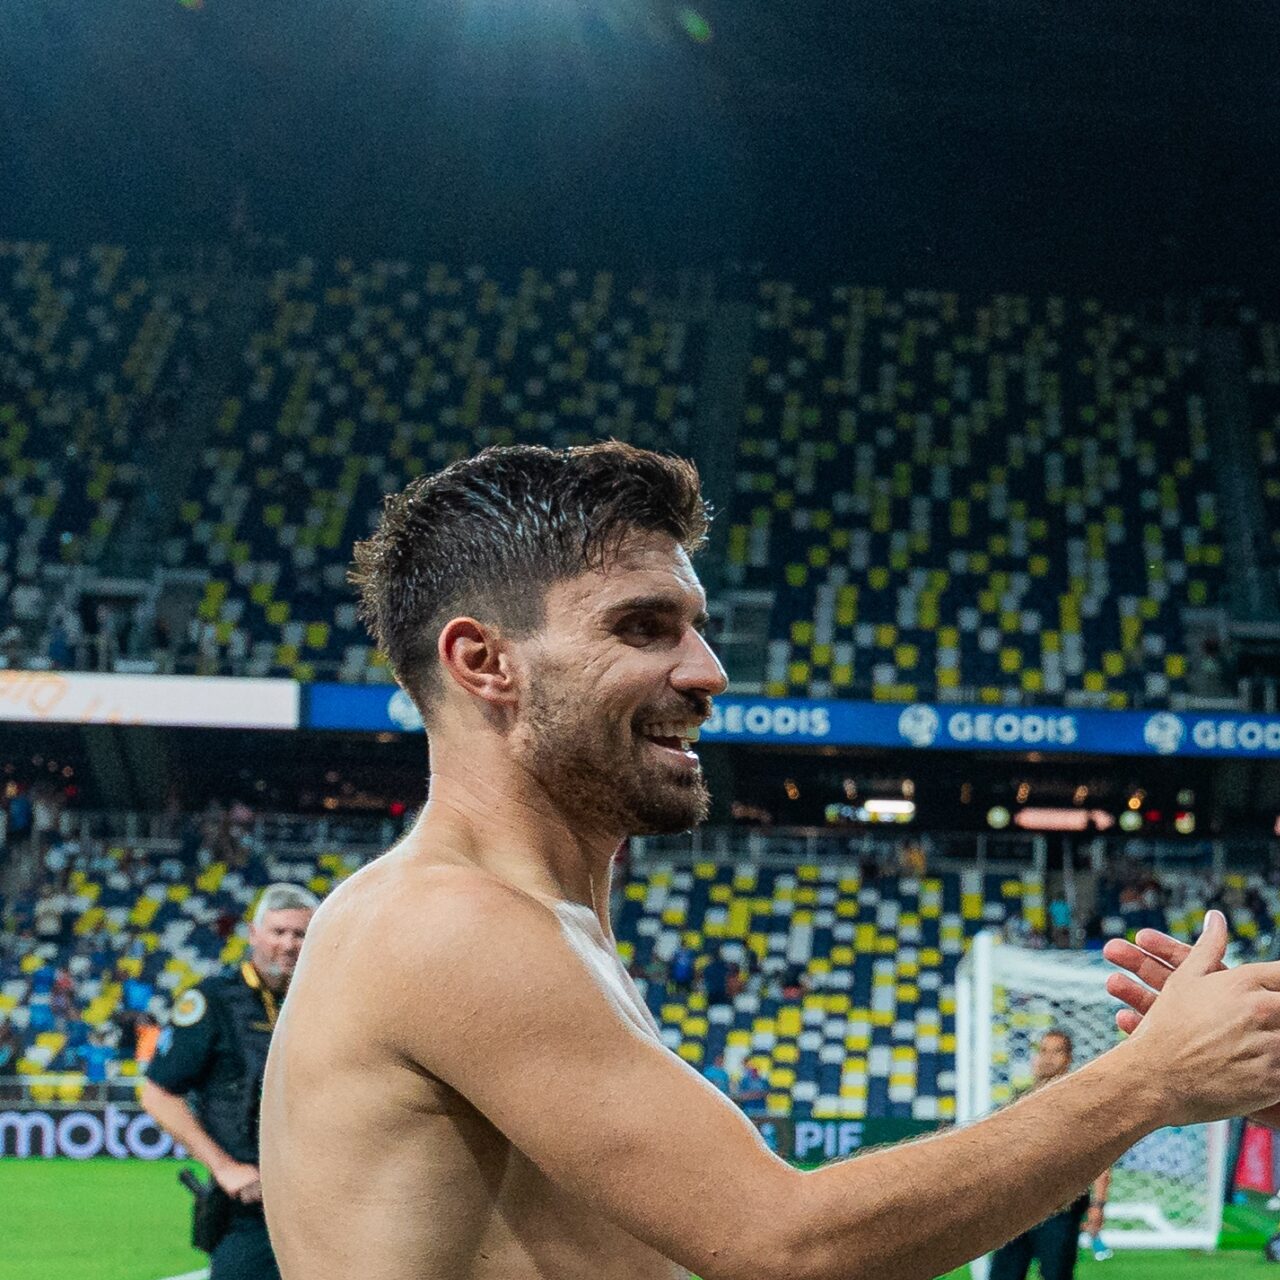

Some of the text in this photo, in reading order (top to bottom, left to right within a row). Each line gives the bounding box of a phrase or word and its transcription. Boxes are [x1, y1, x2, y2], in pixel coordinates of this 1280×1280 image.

[702, 703, 831, 737] GEODIS
[949, 710, 1077, 745] GEODIS
[0, 1104, 188, 1159] moto
[795, 1121, 864, 1158] PIF
